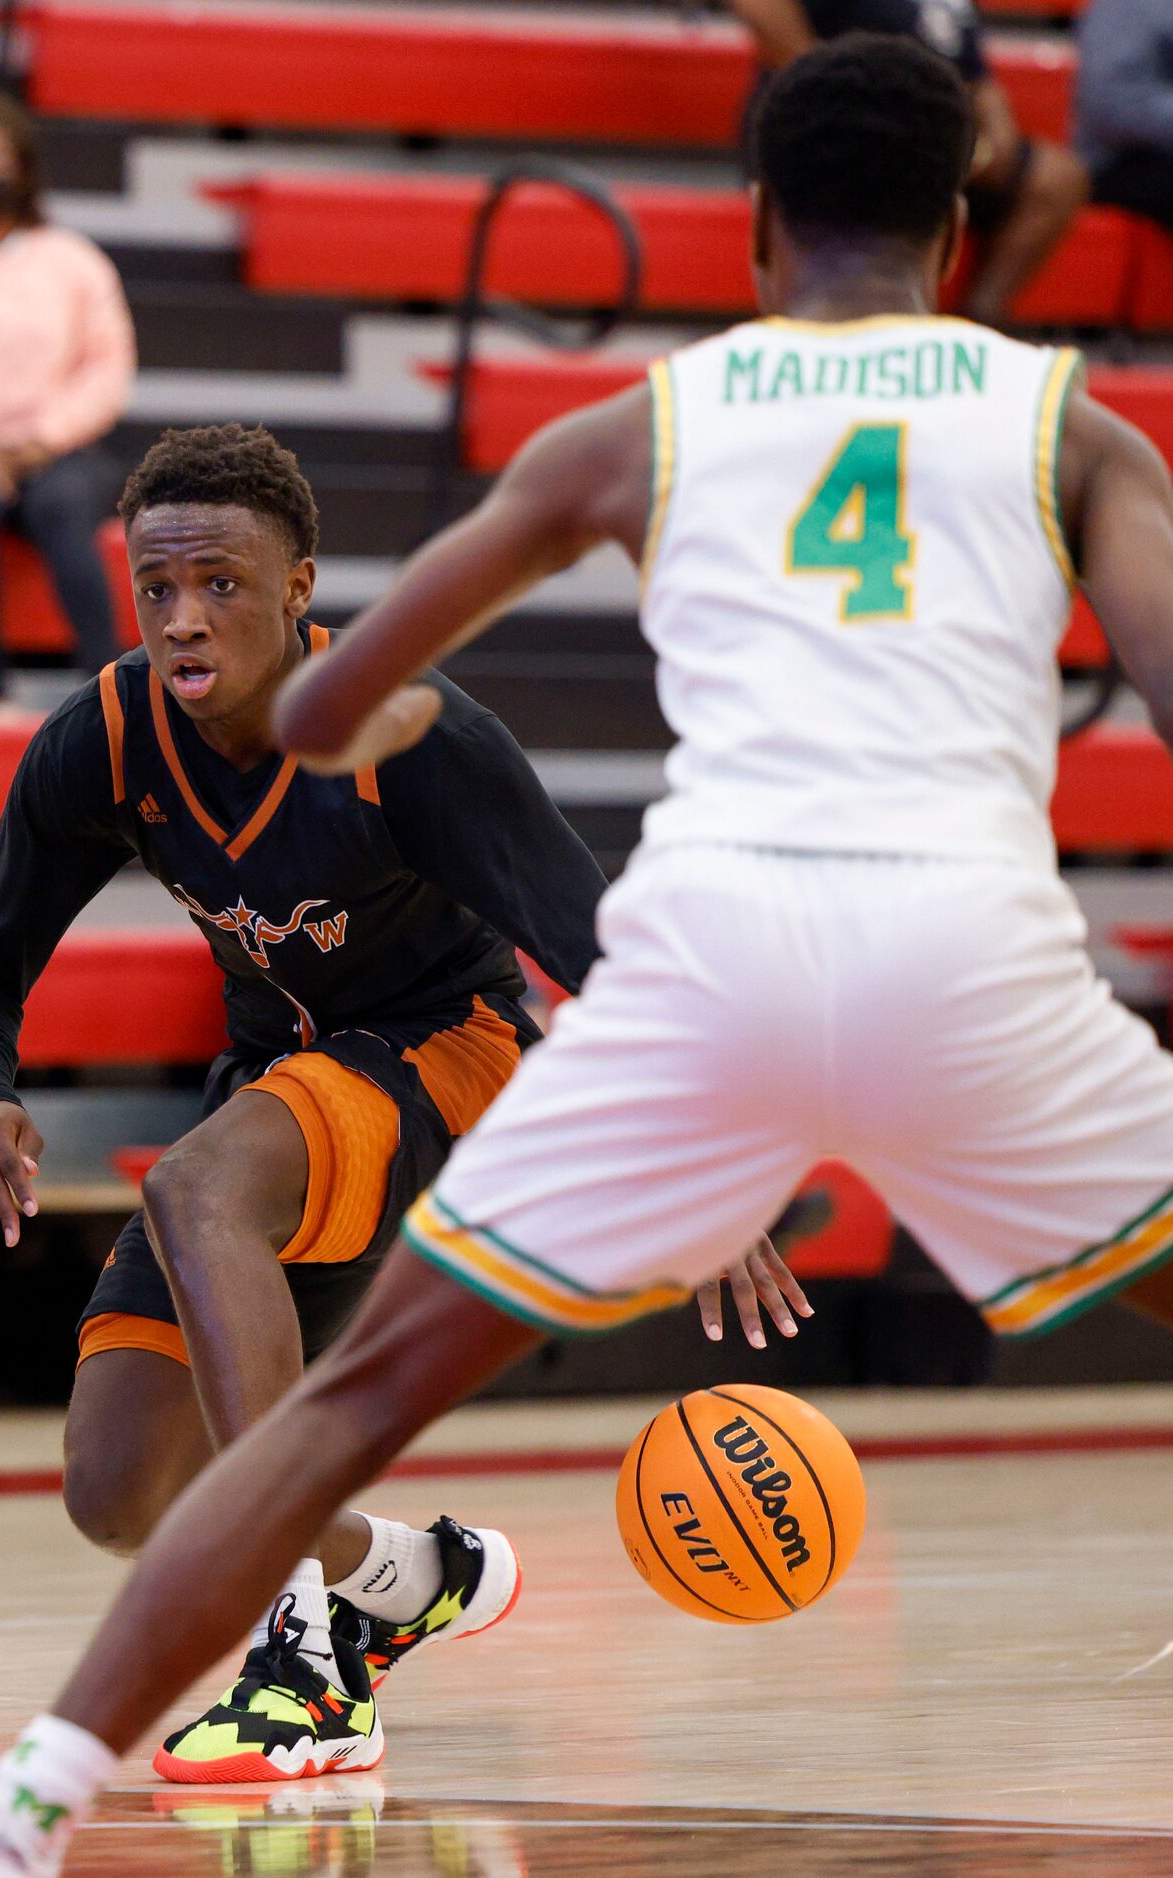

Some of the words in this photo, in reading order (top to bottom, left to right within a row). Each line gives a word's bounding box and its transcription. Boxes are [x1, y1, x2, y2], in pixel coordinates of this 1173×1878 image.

[725, 341, 987, 403] MADISON
[783, 418, 917, 627] 4
[303, 910, 348, 953] W
[713, 1416, 810, 1573] Wilson
[727, 1471, 746, 1498] INDOOR
[745, 1499, 759, 1520] GAME
[757, 1521, 769, 1540] BALL
[660, 1492, 729, 1573] EVO
[724, 1571, 752, 1592] NXT
